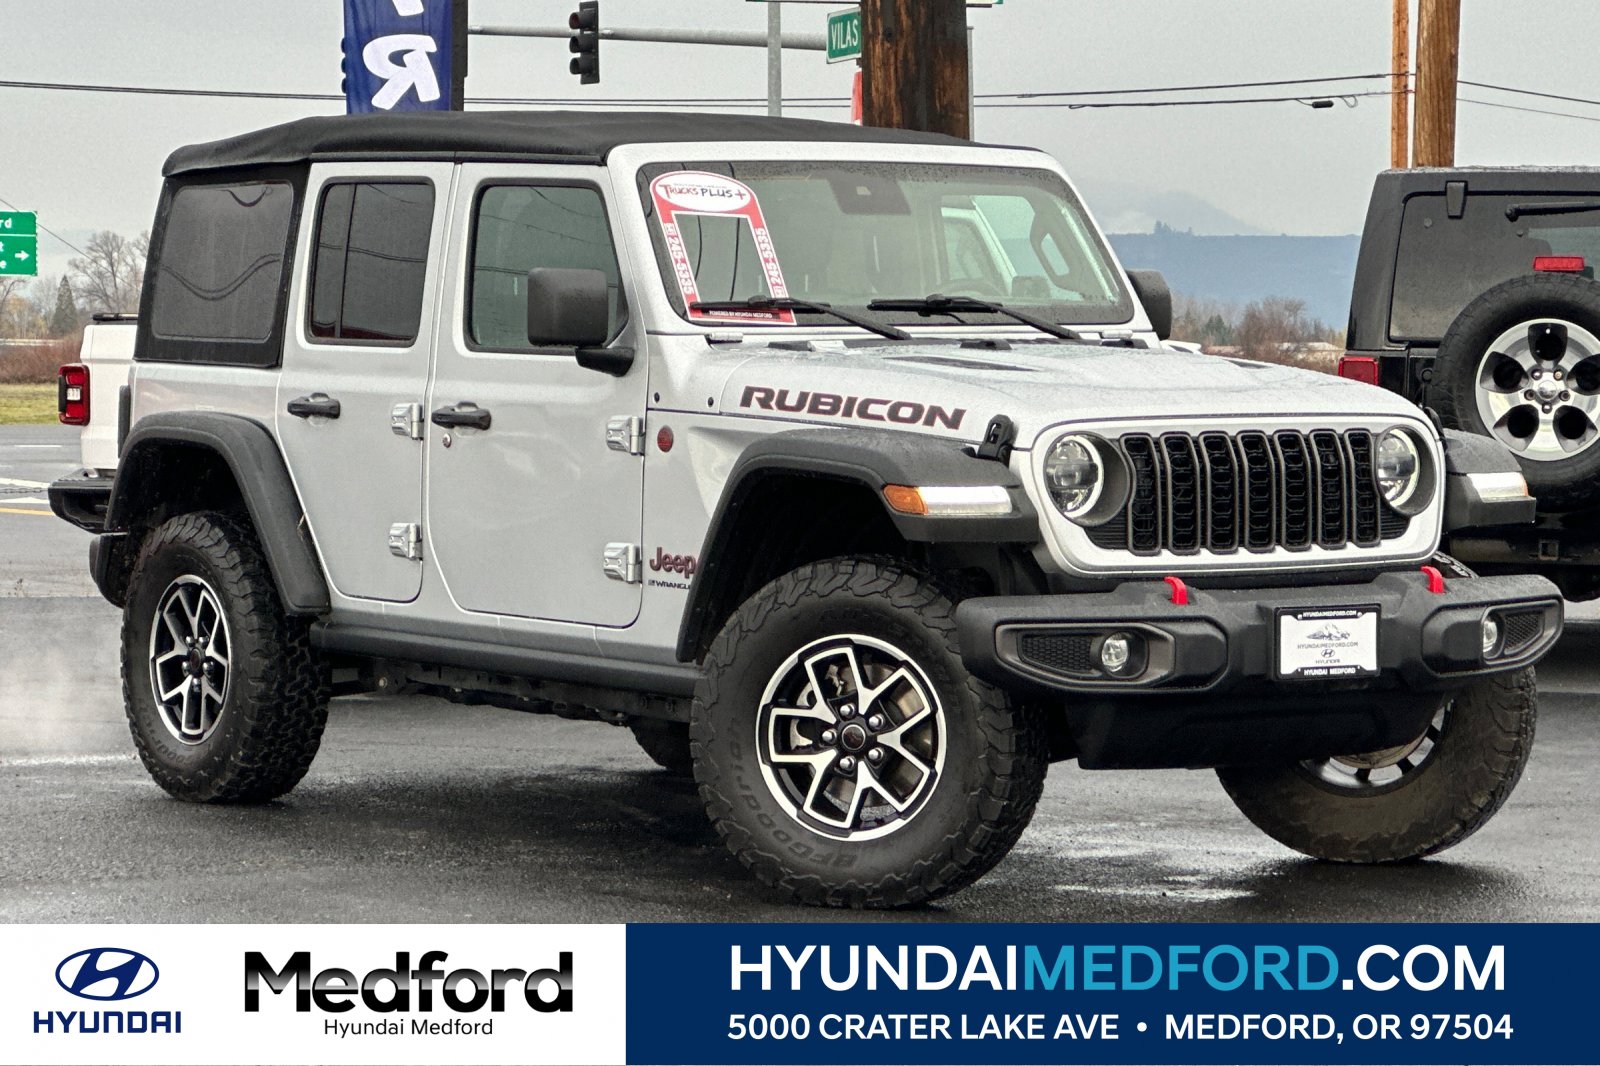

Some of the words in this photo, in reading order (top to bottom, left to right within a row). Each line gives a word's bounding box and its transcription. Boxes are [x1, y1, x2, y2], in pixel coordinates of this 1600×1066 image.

[831, 19, 858, 50] VILAS
[739, 385, 967, 430] RUBICON
[649, 546, 697, 579] Jeep
[1302, 610, 1357, 618] HYUNDAIMEDFORD.COM
[1304, 668, 1328, 676] HYUNDAI
[1329, 667, 1356, 675] MEDFORD
